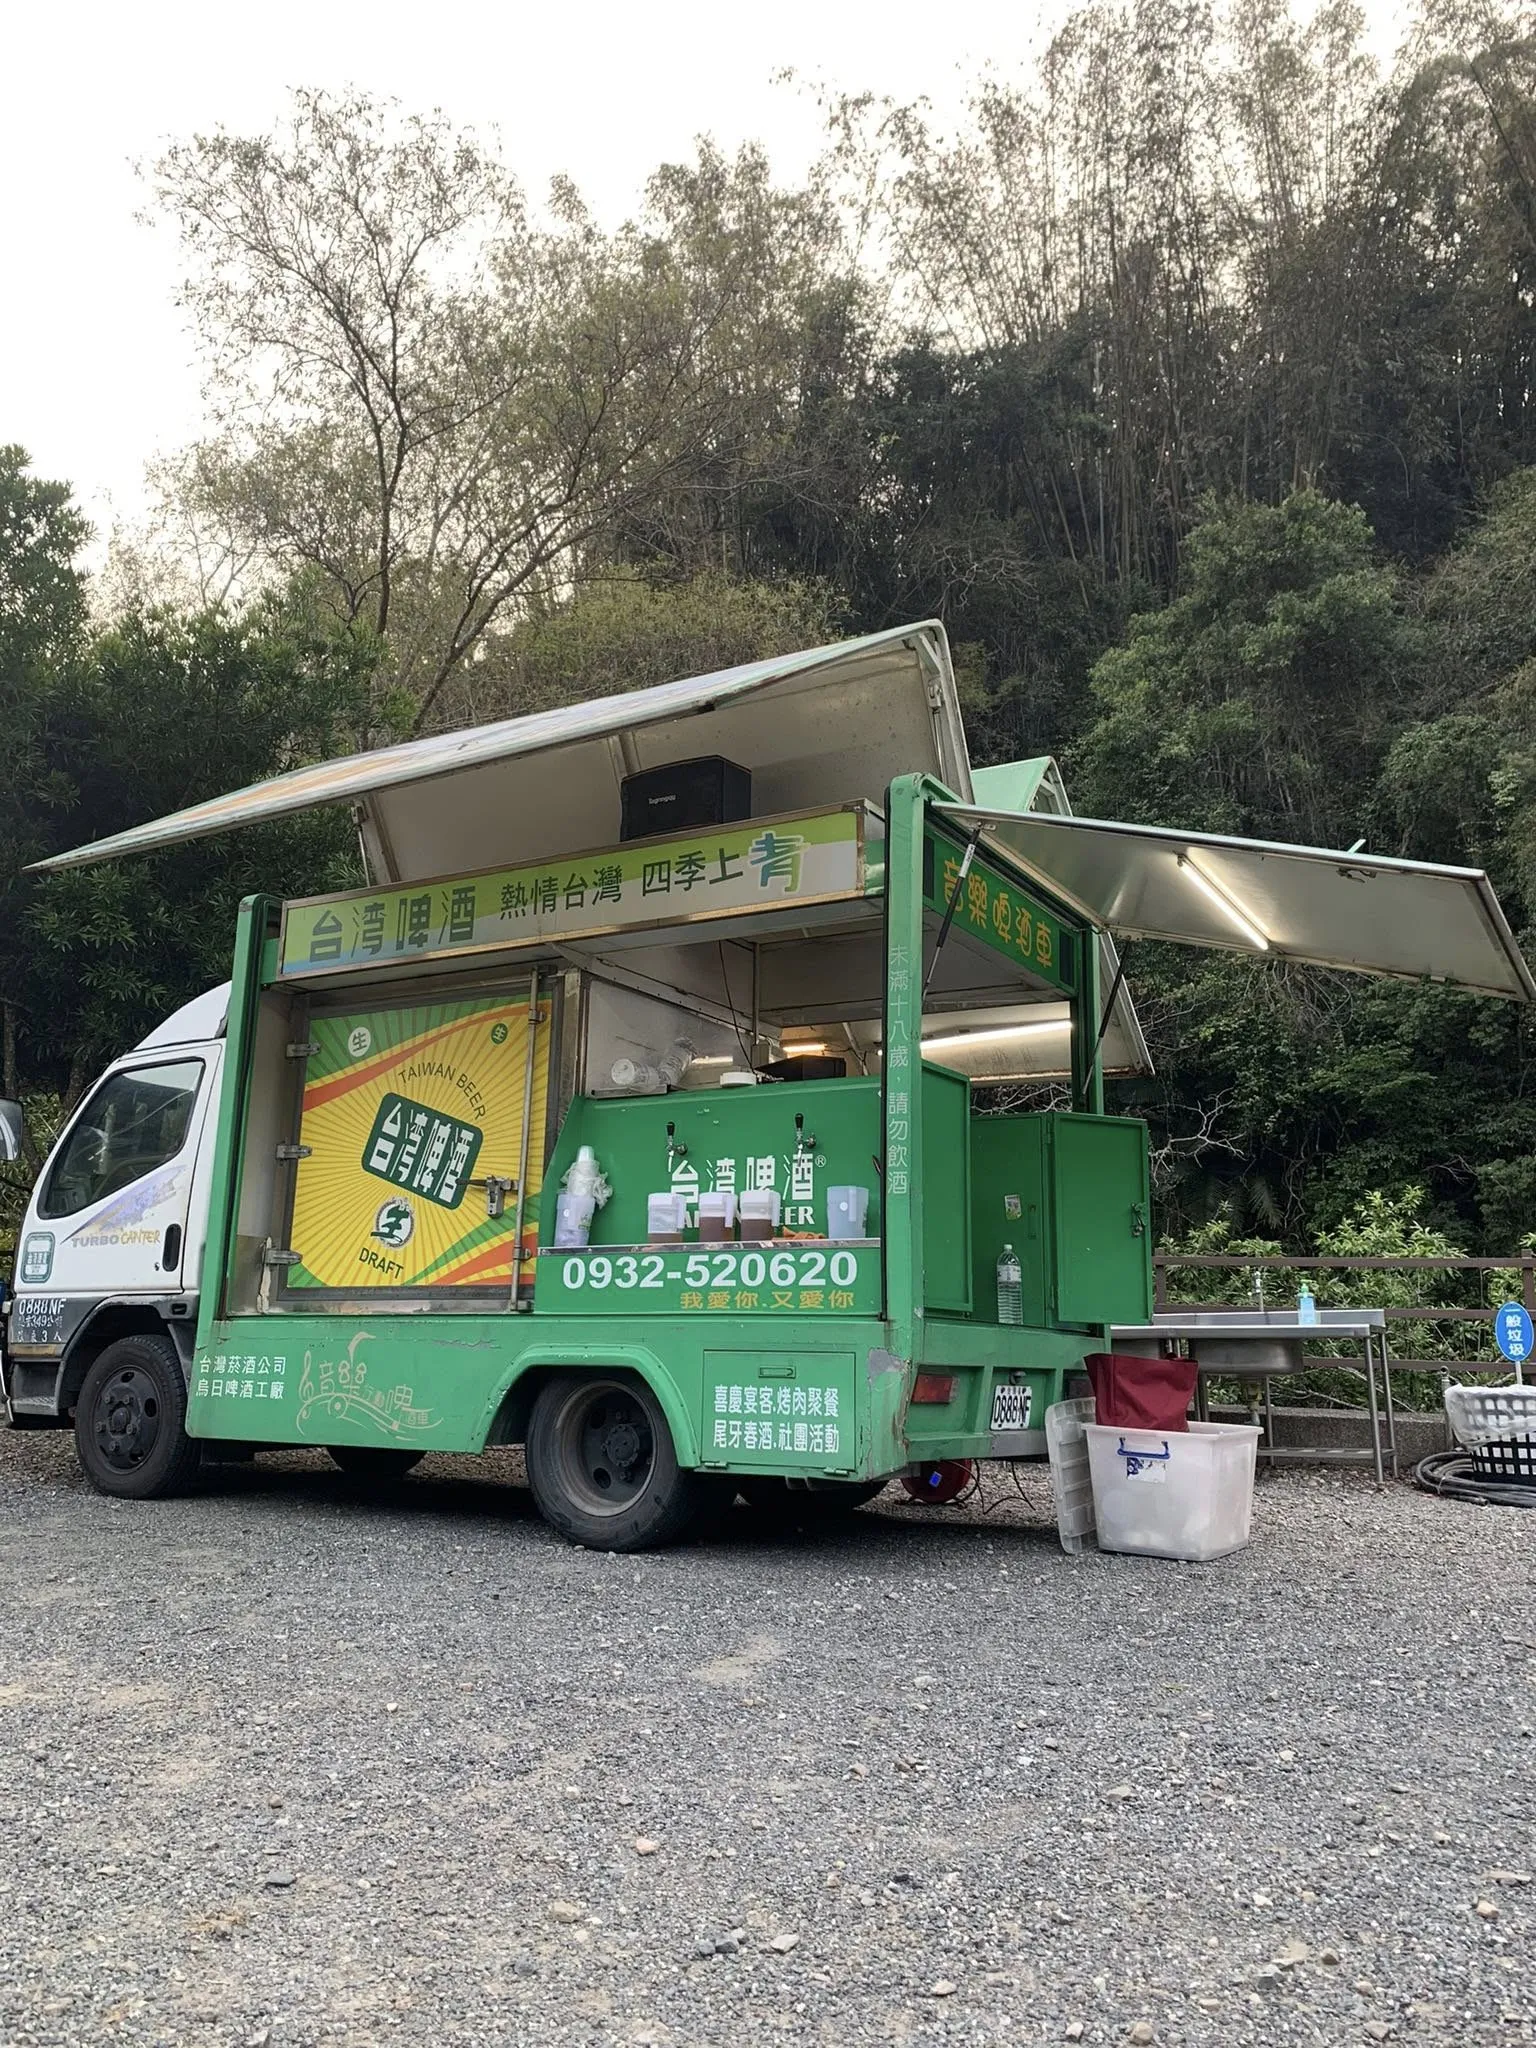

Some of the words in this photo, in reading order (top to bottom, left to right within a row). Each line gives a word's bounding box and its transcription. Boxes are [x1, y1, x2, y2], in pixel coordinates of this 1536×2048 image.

[500, 863, 622, 921] 熱情台灣
[641, 831, 804, 897] 四季上青
[351, 1032, 367, 1052] 生
[398, 1062, 456, 1084] TAIWAN
[456, 1073, 486, 1120] BEER
[71, 1235, 119, 1248] TURBO
[120, 1228, 161, 1246] CANTER
[358, 1247, 404, 1279] DRAFT
[562, 1251, 858, 1289] 0932-520620
[18, 1299, 66, 1316] 0888NF
[1504, 1308, 1525, 1356] 一般垃圾
[199, 1355, 286, 1375] 台灣菸酒公司
[195, 1379, 285, 1399] 烏日啤酒工廠
